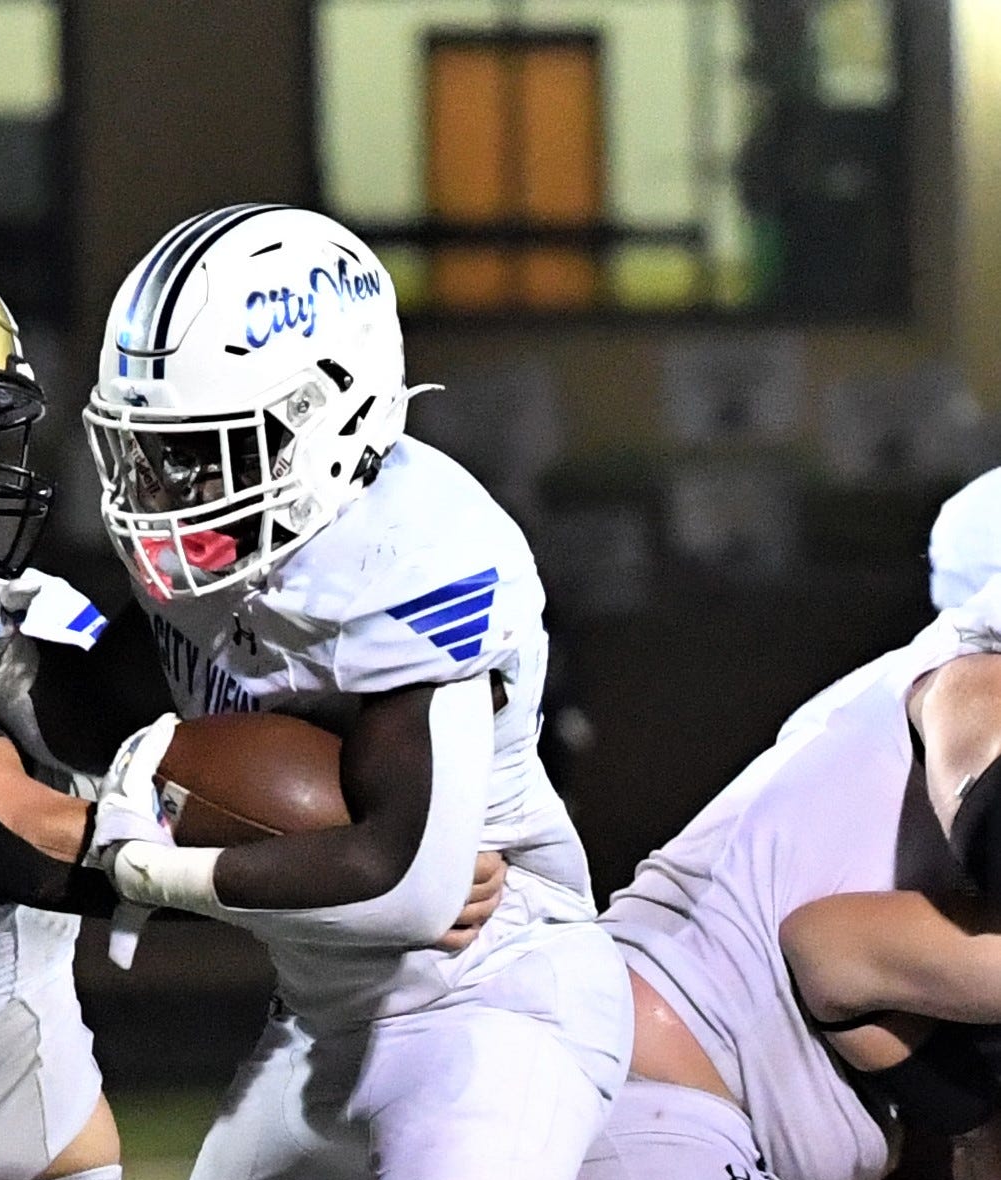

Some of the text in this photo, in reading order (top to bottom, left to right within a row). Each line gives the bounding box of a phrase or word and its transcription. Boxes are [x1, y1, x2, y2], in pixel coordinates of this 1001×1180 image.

[246, 256, 381, 349] City View
[152, 613, 200, 696] CITY
